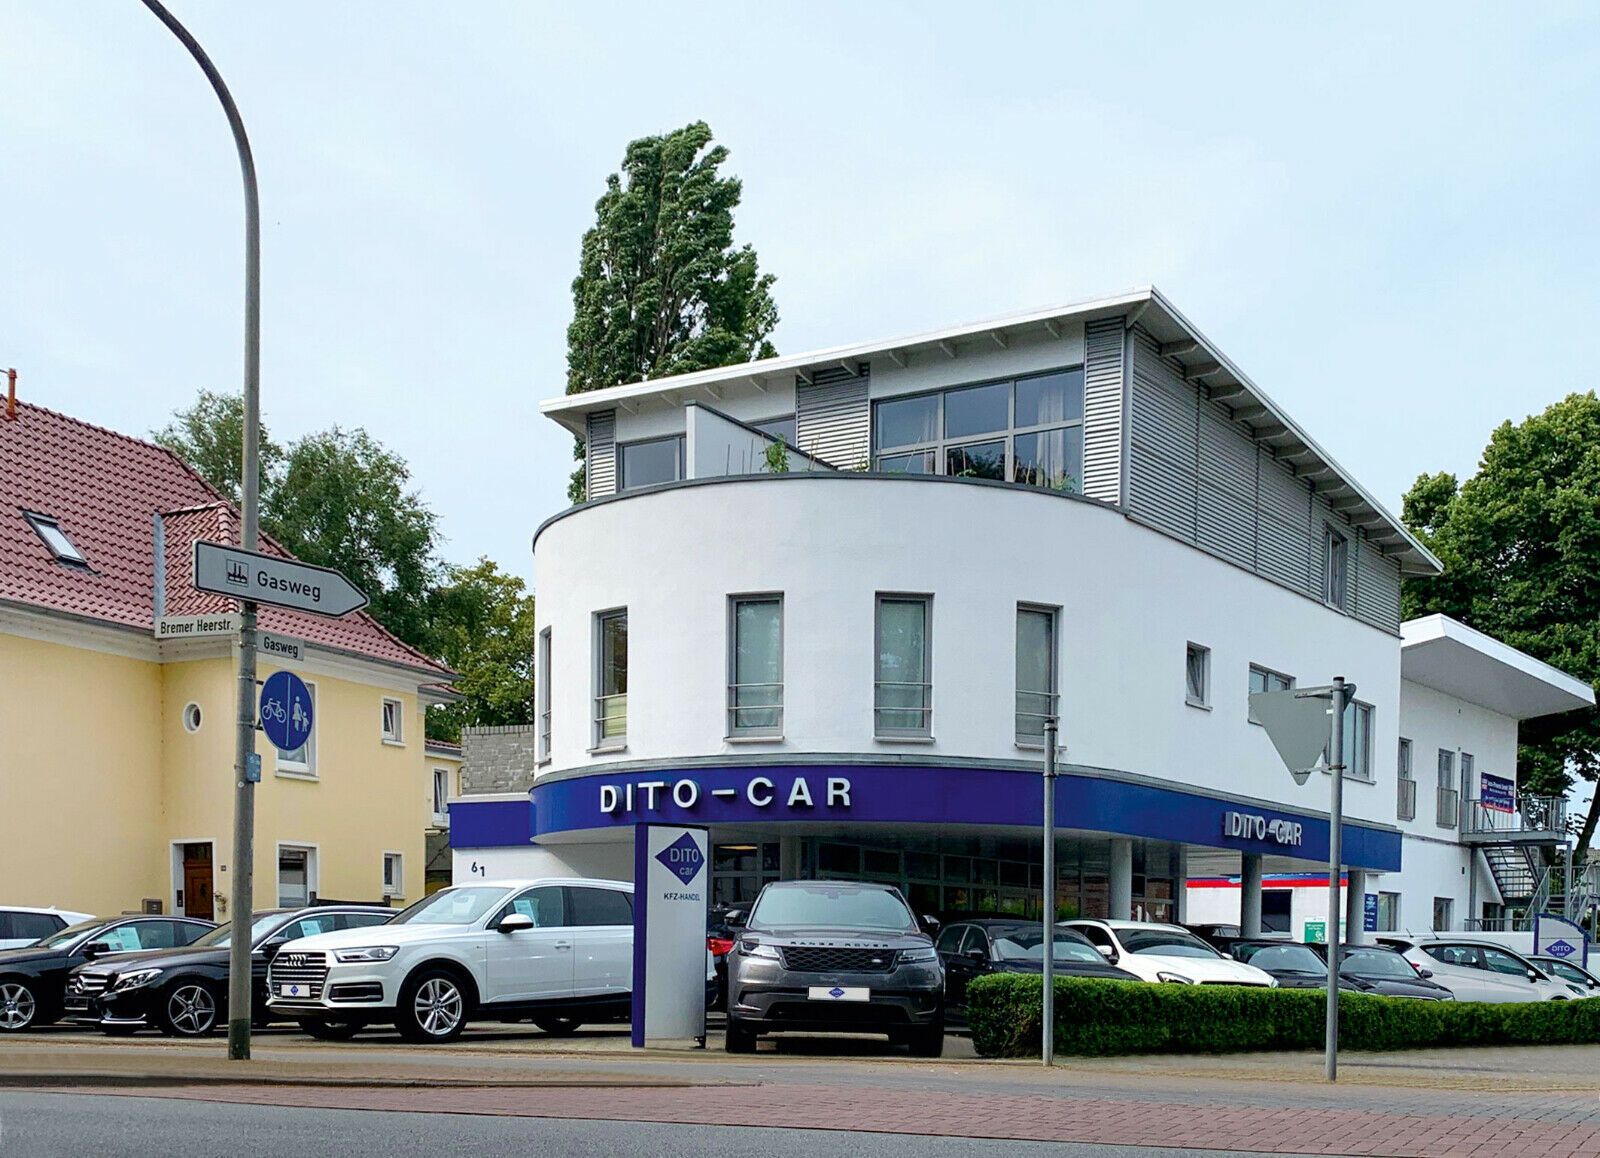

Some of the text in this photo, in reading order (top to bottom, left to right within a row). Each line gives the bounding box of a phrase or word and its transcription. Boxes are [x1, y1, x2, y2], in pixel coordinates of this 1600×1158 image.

[257, 570, 321, 602] Gasweg
[160, 619, 234, 634] Bremer Heerstr.
[263, 636, 299, 659] Gasweg
[670, 848, 699, 863] DITO
[471, 861, 485, 877] 61
[679, 867, 693, 875] car
[663, 892, 701, 901] KFZ-HANDEL
